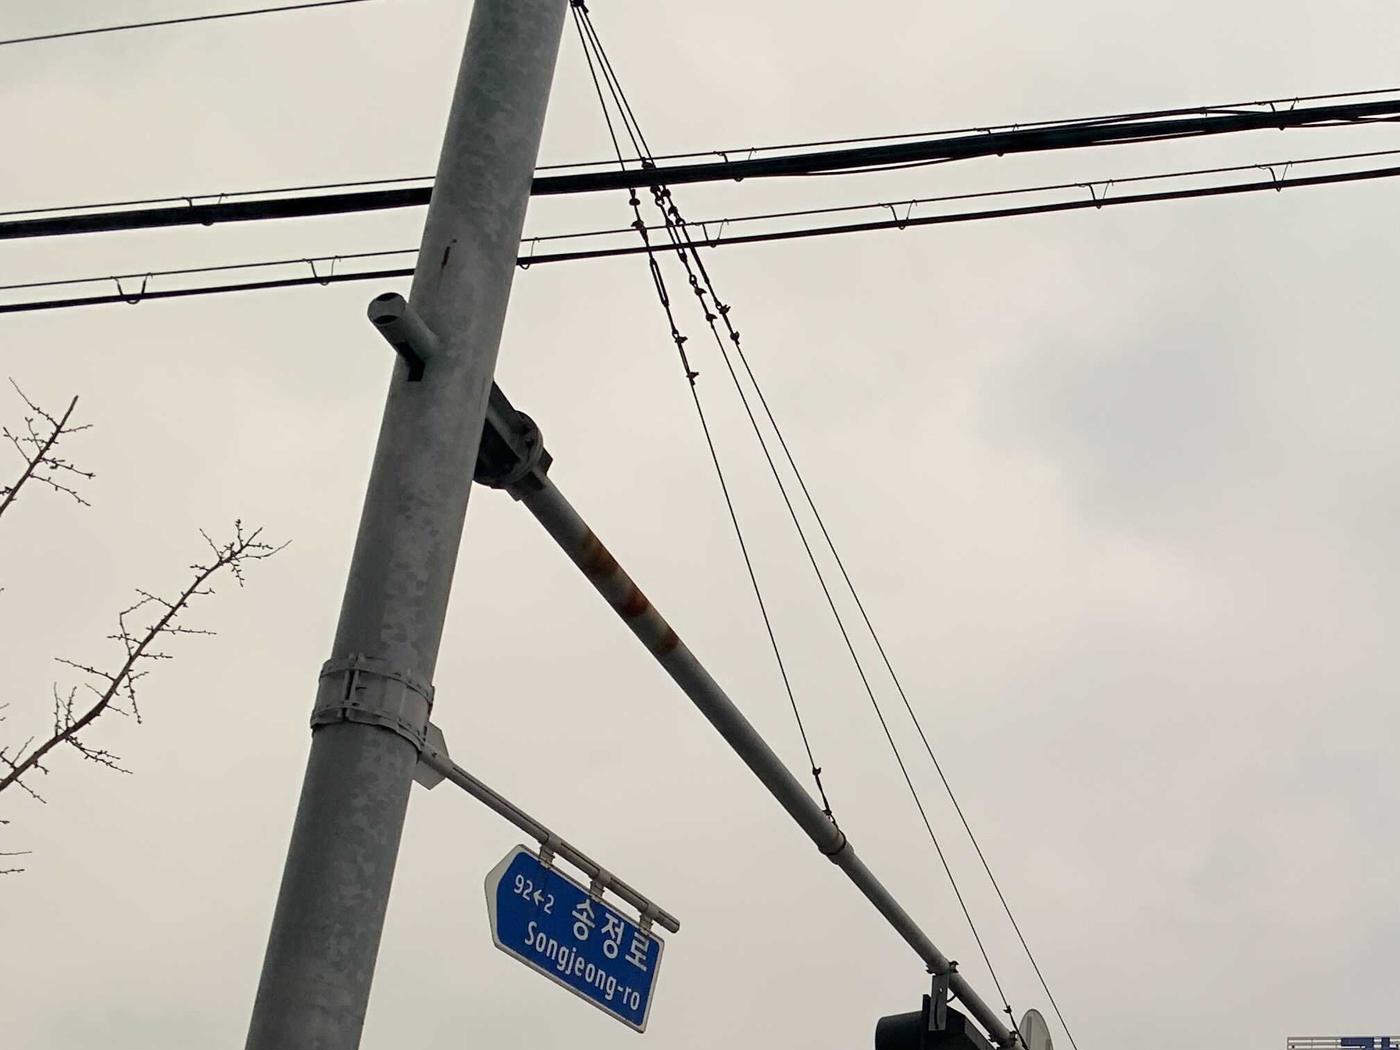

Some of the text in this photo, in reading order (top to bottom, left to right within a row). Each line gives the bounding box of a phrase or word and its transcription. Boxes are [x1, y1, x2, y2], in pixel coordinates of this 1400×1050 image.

[513, 874, 533, 901] 92
[524, 921, 640, 1011] Songjeong-ro
[572, 899, 650, 972] 송정로
